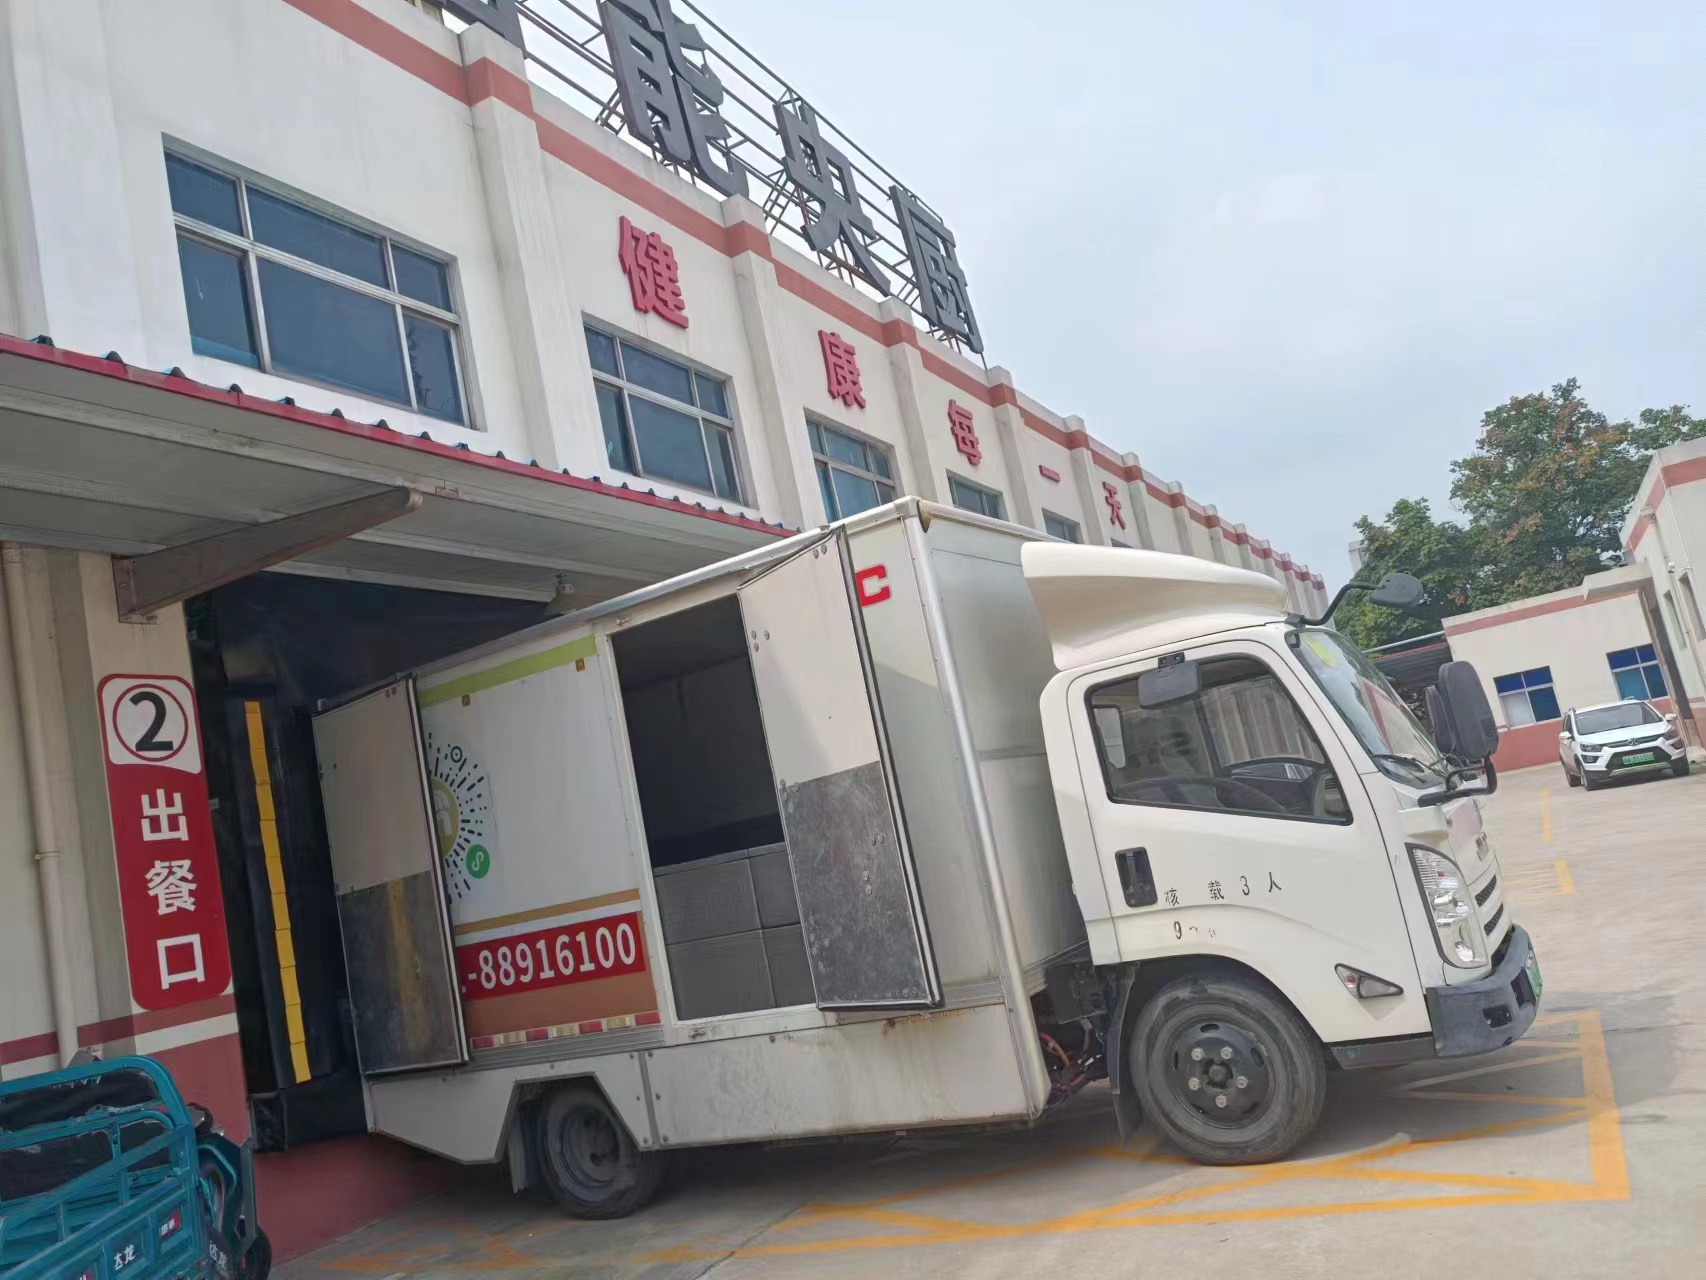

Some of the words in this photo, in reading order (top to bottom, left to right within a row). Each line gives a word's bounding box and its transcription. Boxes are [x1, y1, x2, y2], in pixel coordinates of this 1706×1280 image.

[618, 216, 1126, 530] 健康每一天
[128, 691, 174, 752] 2
[140, 788, 205, 990] 出餐口
[461, 922, 636, 993] -88916100
